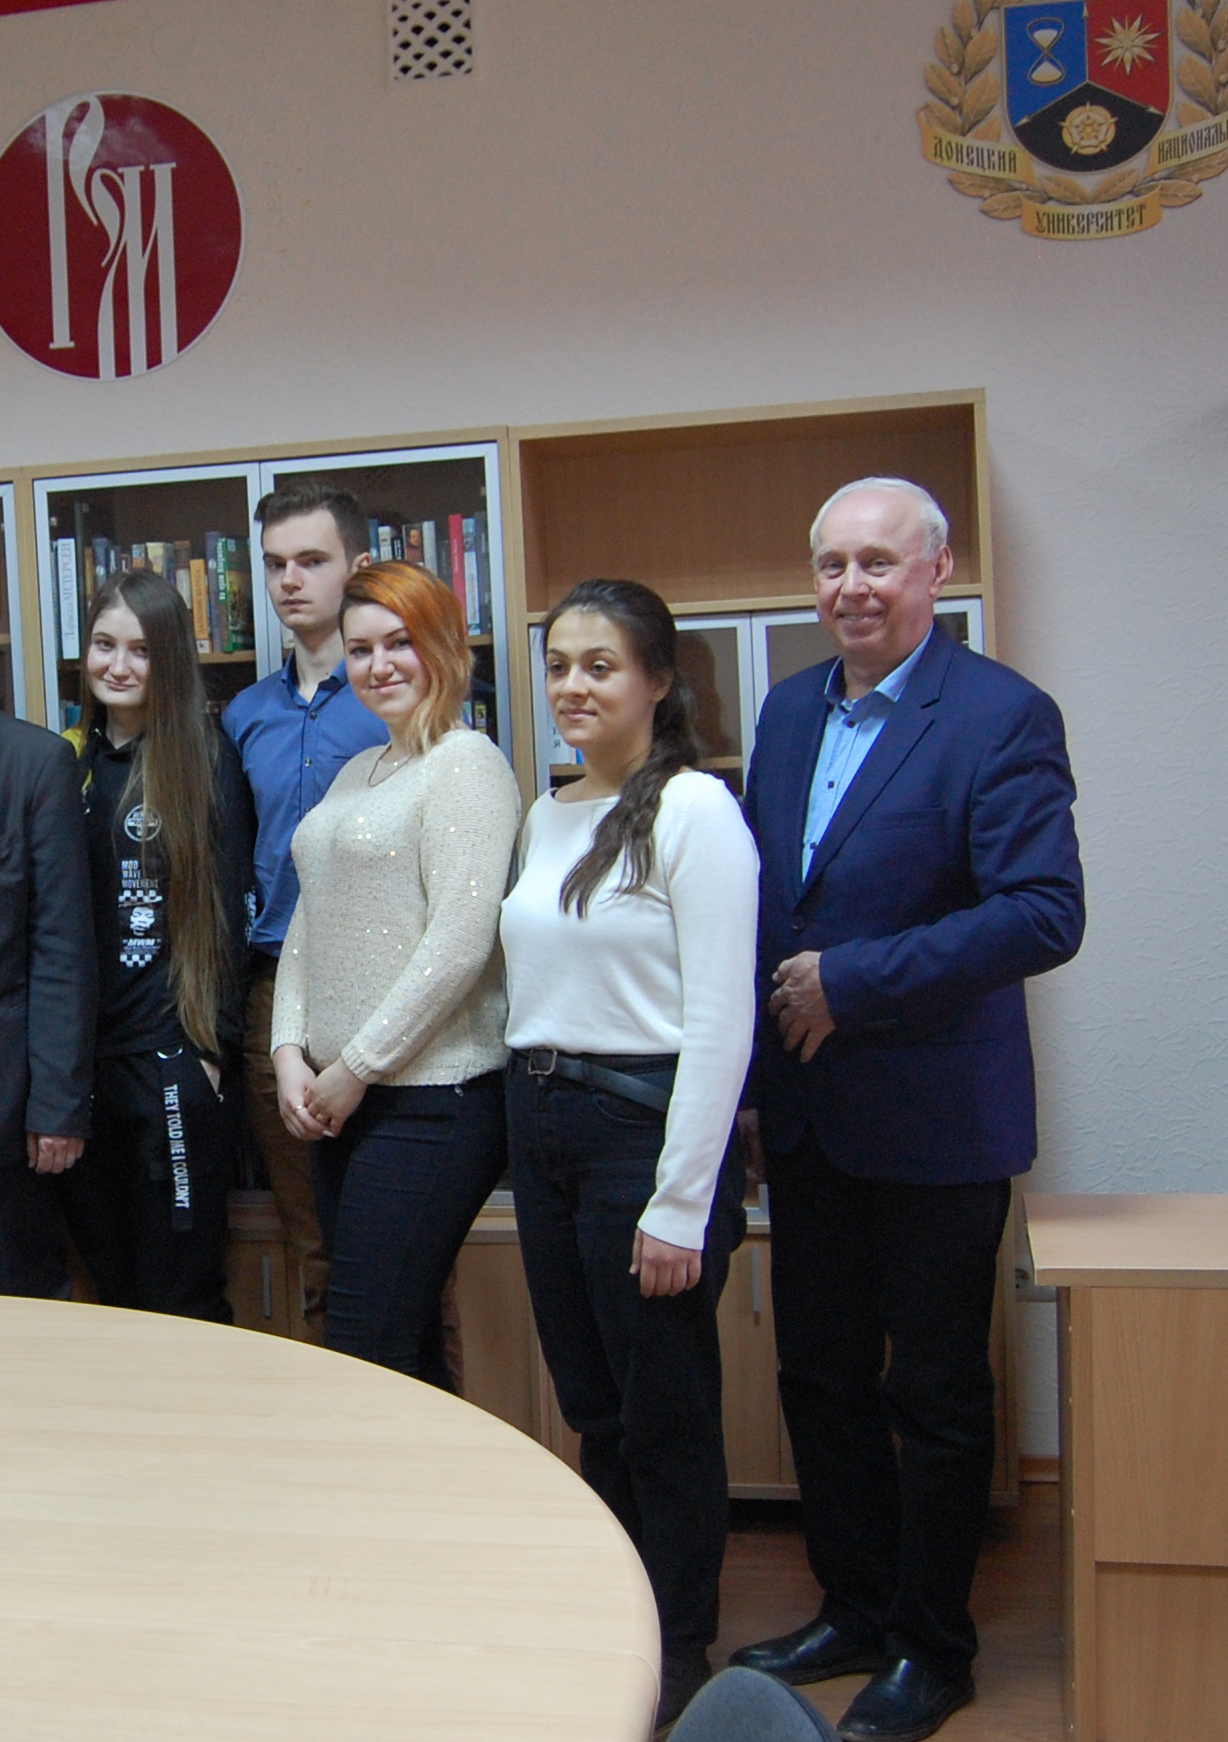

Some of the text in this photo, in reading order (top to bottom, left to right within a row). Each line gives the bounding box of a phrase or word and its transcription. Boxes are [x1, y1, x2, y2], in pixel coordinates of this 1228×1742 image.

[933, 135, 1018, 174] ДОНЕЦКИЙ
[1035, 202, 1147, 235] УНИВЕРСИТЕТ
[163, 1084, 179, 1111] THEY
[166, 1112, 183, 1139] TOLD
[169, 1140, 186, 1154] ME
